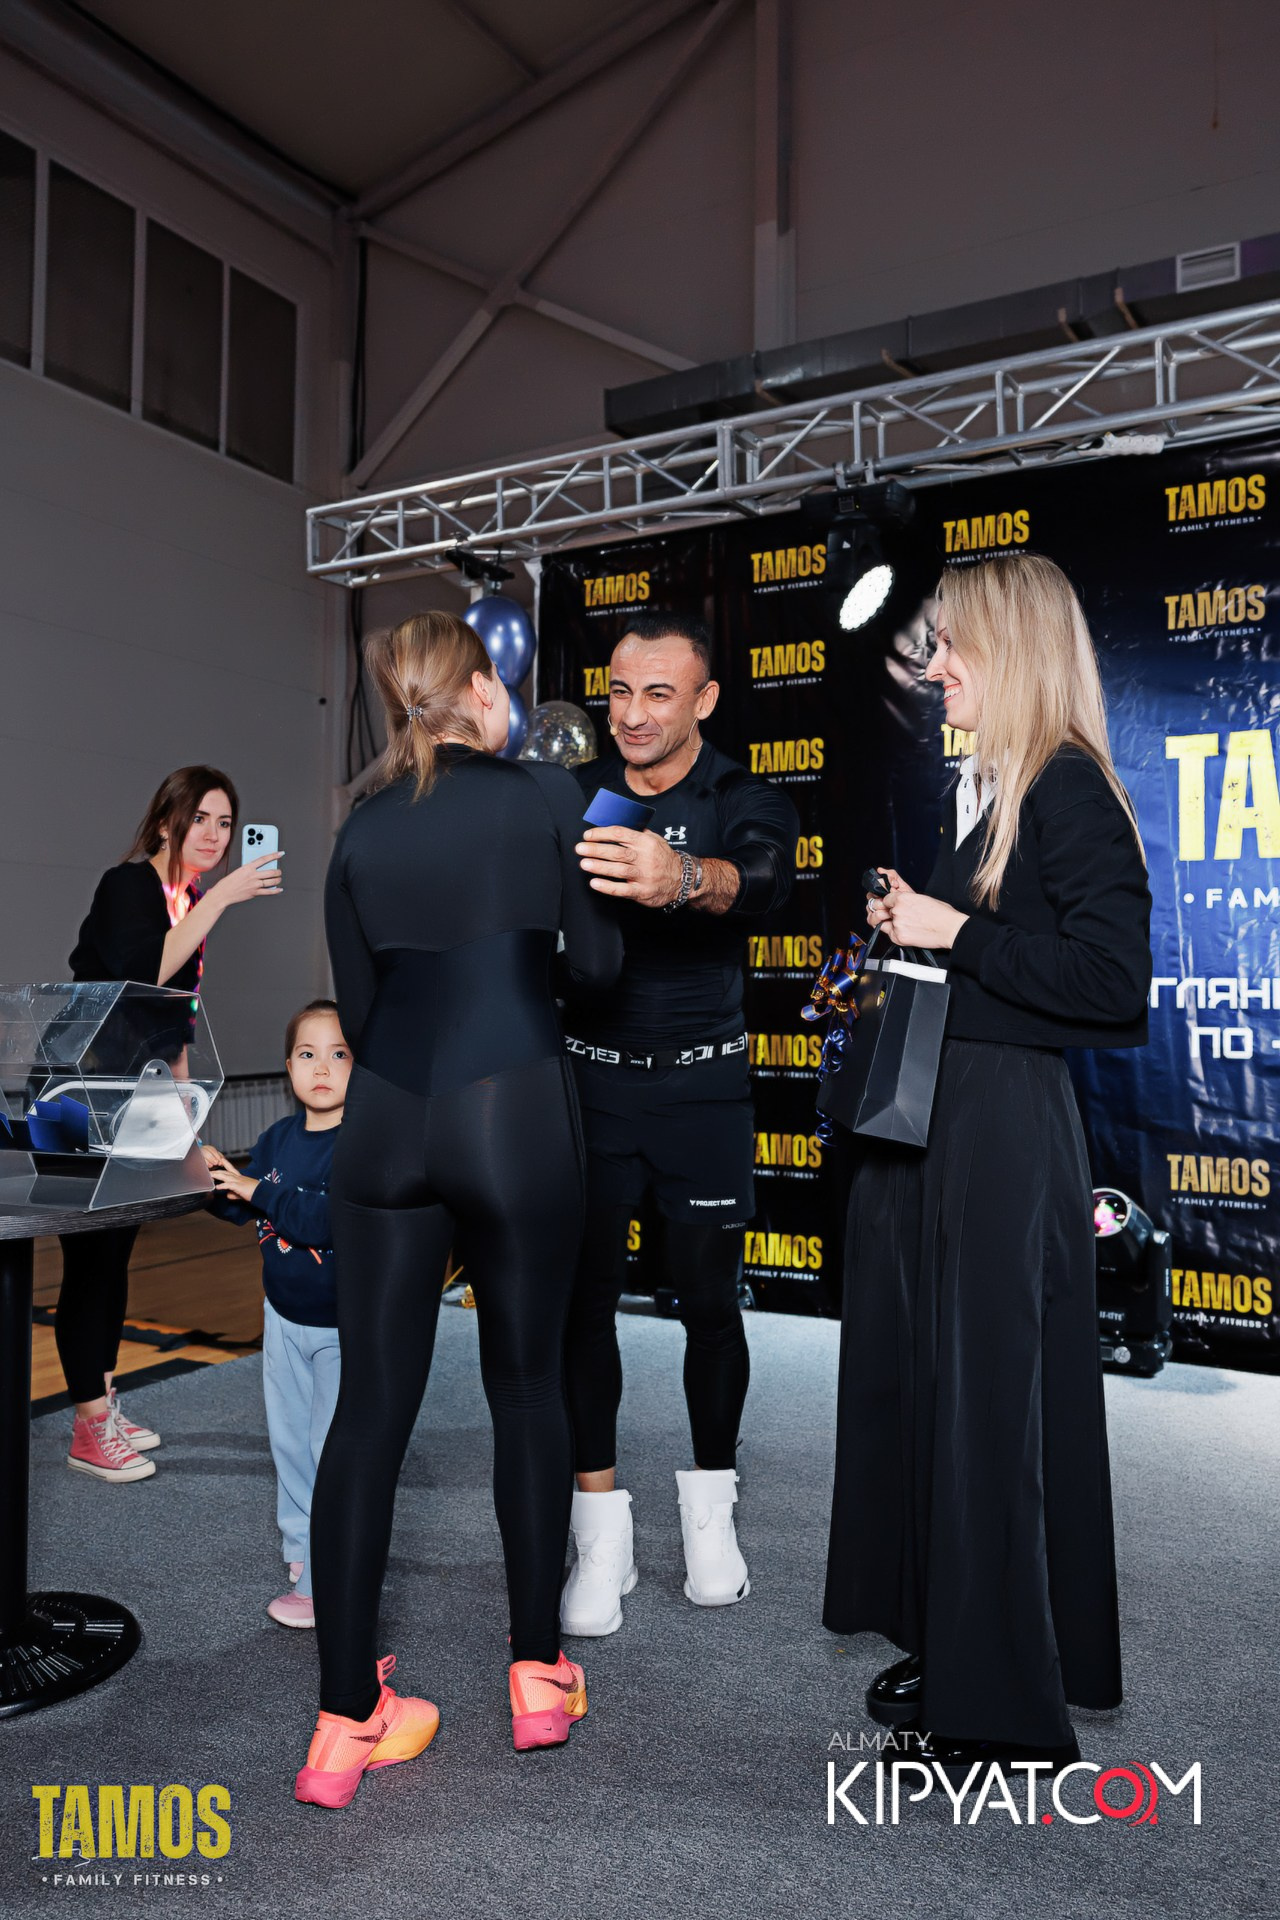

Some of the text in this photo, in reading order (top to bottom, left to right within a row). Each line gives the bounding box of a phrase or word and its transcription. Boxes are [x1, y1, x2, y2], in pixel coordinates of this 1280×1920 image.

[1165, 474, 1266, 522] TAMOS
[943, 509, 1030, 553] TAMOS
[1175, 516, 1255, 533] FAMILY FITNESS
[751, 544, 827, 583] TAMOS
[951, 549, 1020, 564] FAMILY FITNESS
[584, 571, 650, 607] TAMOS
[758, 580, 819, 593] FAMILY FITNESS
[1164, 584, 1266, 630] TAMOS
[1174, 627, 1255, 643] FAMILY FITNESS
[749, 640, 825, 678] TAMOS
[757, 677, 817, 689] FAMILY FITNESS
[749, 738, 824, 774] TAMOS
[785, 774, 816, 783] FITNESS
[748, 935, 823, 968] TAMOS
[748, 1033, 823, 1067] TAMOS
[1190, 1026, 1254, 1060] ПО
[753, 1131, 822, 1168] AMOS
[1166, 1154, 1271, 1197] TAMOS
[721, 1198, 736, 1206] ROCK
[1178, 1197, 1260, 1210] FAMILY FITNESS
[744, 1231, 823, 1270] TAMOS
[749, 1269, 814, 1281] FAMILY FITNESS
[1171, 1269, 1272, 1316] TAMOS
[1179, 1313, 1262, 1328] FAMILY FITNESS
